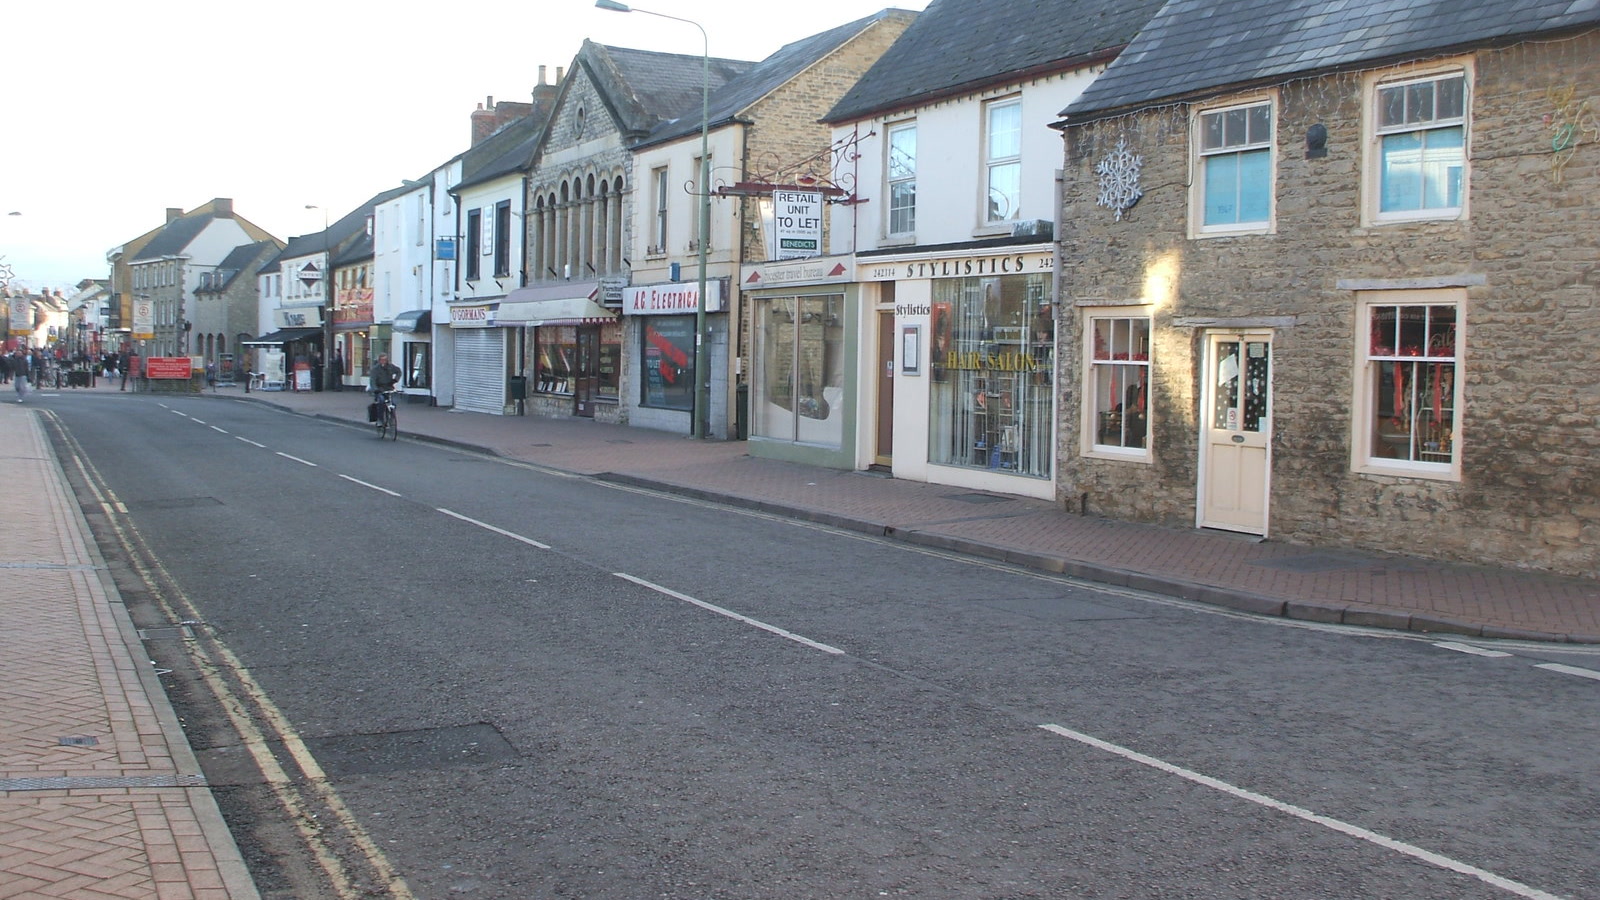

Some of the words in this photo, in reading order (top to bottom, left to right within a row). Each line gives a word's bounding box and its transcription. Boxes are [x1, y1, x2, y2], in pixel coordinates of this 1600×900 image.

[779, 193, 817, 203] RETAIL
[787, 205, 809, 215] UNIT
[777, 216, 793, 228] TO
[798, 217, 820, 229] LET
[782, 240, 815, 249] BENEDICTS
[906, 256, 1024, 278] STYLISTICS
[1039, 258, 1054, 269] 242
[786, 266, 802, 280] travel
[803, 266, 823, 279] bureau
[874, 267, 895, 278] 242314
[650, 290, 698, 310] ELECTRICA
[895, 303, 931, 318] Stylistics
[947, 351, 981, 370] HAIR
[986, 351, 1036, 372] SALON
